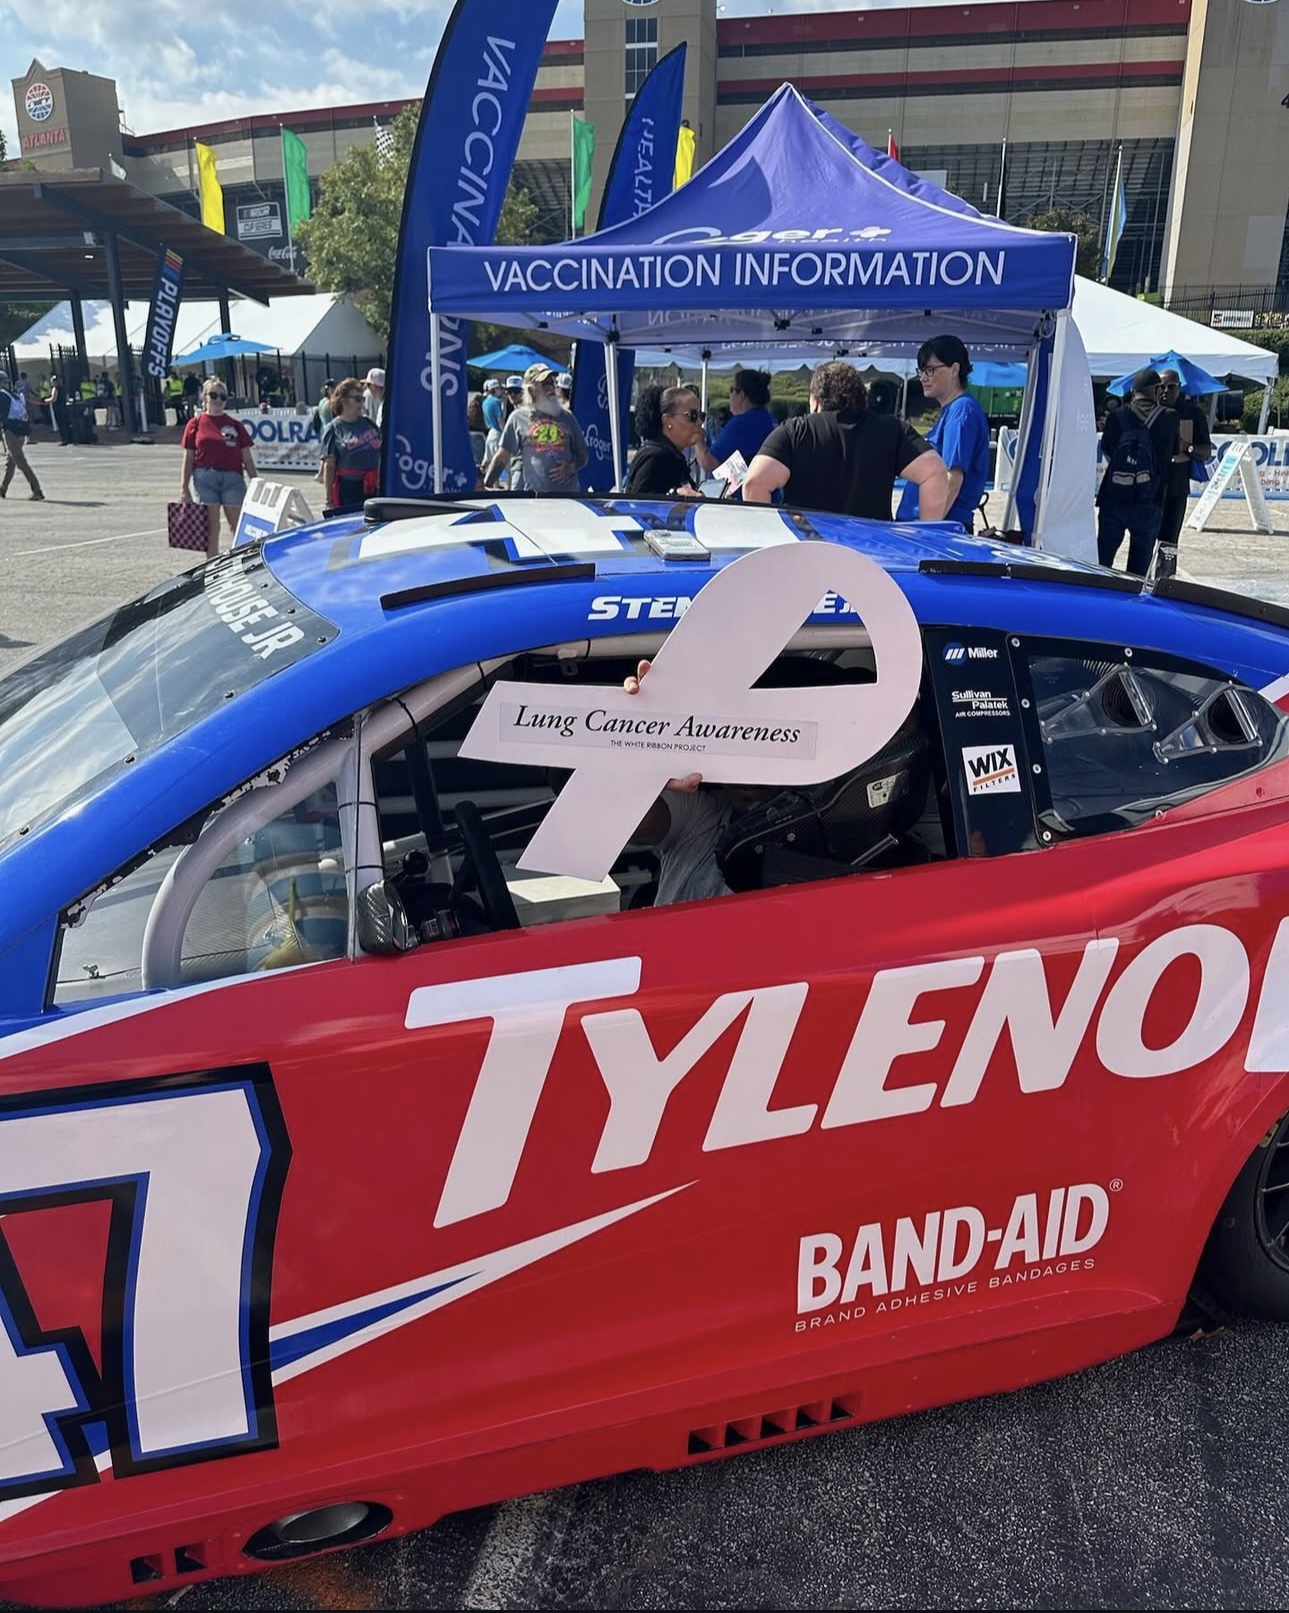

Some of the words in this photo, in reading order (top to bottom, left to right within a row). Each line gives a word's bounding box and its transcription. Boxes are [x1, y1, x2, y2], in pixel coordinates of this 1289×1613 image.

[24, 127, 66, 150] ATLANTA
[483, 254, 719, 291] VACCINATION
[735, 251, 1004, 286] INFORMATION
[147, 277, 179, 379] PLAYOFFS
[241, 621, 304, 660] JR
[967, 647, 999, 659] Miller
[951, 690, 991, 700] Sullivan
[971, 700, 1009, 711] Palatek
[513, 705, 578, 737] Lung
[585, 709, 671, 736] Cancer
[673, 715, 801, 743] Awareness
[624, 741, 645, 749] WHITE
[646, 742, 673, 750] RIBBON
[674, 744, 706, 752] PROJECT
[967, 747, 1013, 779] WIX
[973, 773, 1016, 793] FILTERS
[794, 1307, 866, 1332] BRAND
[875, 1281, 978, 1314] ADHESIVE
[988, 1258, 1095, 1289] BANDAGES
